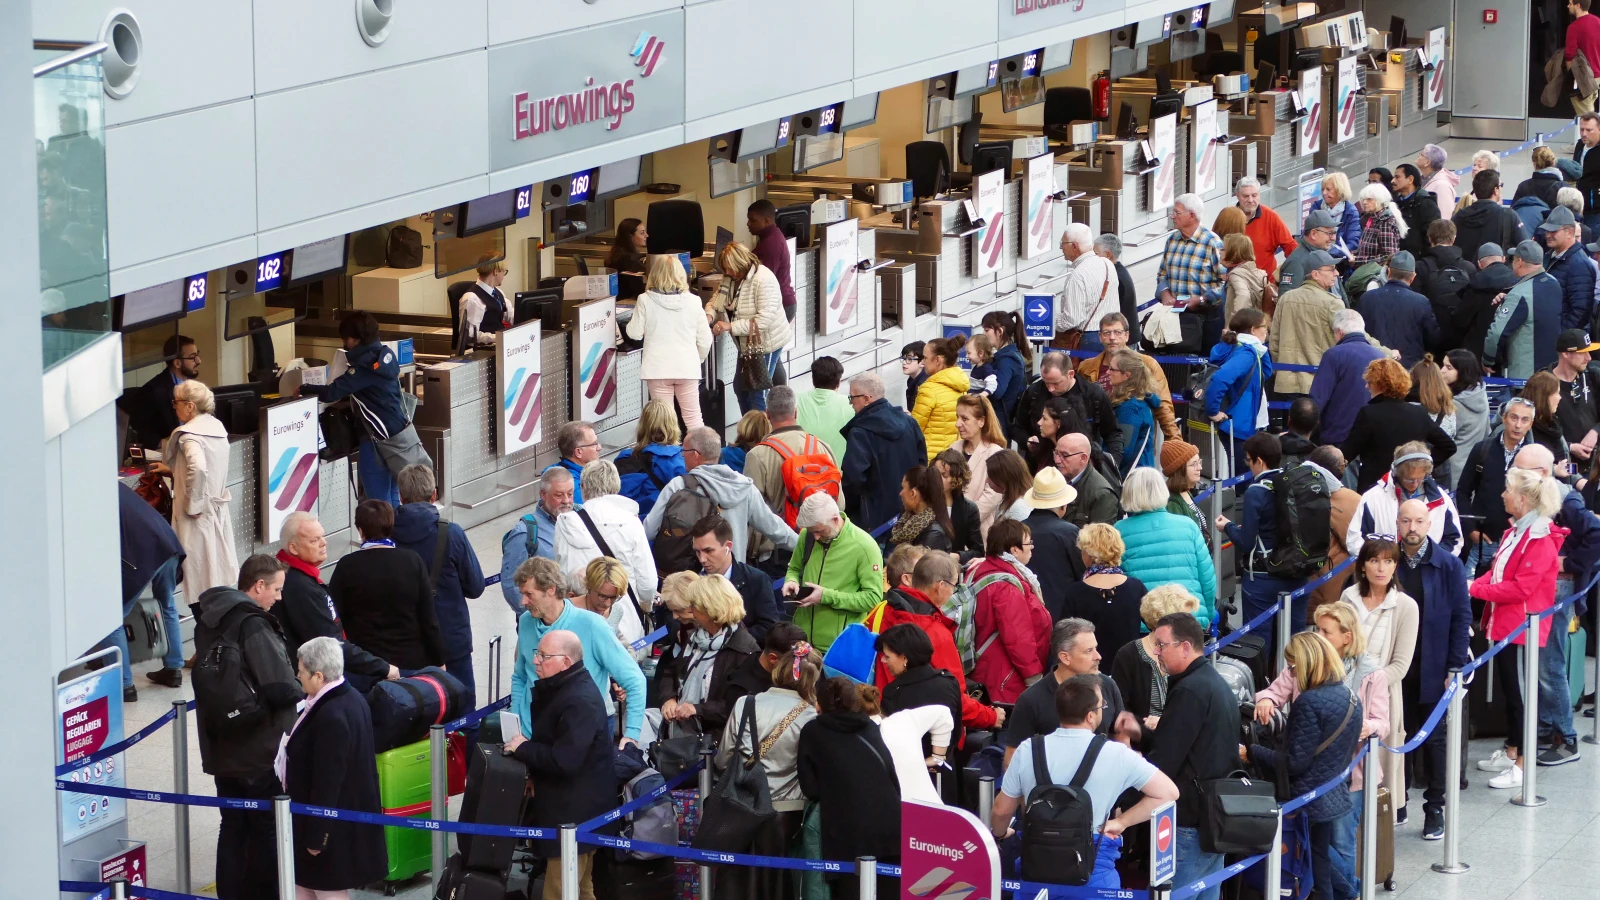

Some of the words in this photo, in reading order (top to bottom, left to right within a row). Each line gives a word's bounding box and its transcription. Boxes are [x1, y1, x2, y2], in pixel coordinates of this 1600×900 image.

[1023, 54, 1036, 70] 156
[512, 76, 634, 140] Eurowings
[820, 108, 835, 126] 158
[570, 175, 590, 196] 160
[517, 190, 530, 210] 61
[830, 238, 850, 249] Eurowings
[257, 258, 280, 282] 162
[188, 278, 205, 302] 63
[583, 318, 606, 332] Eurowings
[507, 343, 530, 357] Eurowings
[273, 420, 304, 436] Eurowings
[66, 694, 85, 704] Eurowings
[66, 710, 88, 727] GEPÄCK
[66, 718, 102, 740] REGULARIEN
[67, 735, 93, 753] LUGGAGE
[324, 809, 338, 818] DUS
[425, 821, 439, 829] DUS
[909, 837, 964, 861] Eurowings
[1005, 882, 1020, 890] DUS
[1117, 891, 1133, 899] DUS
